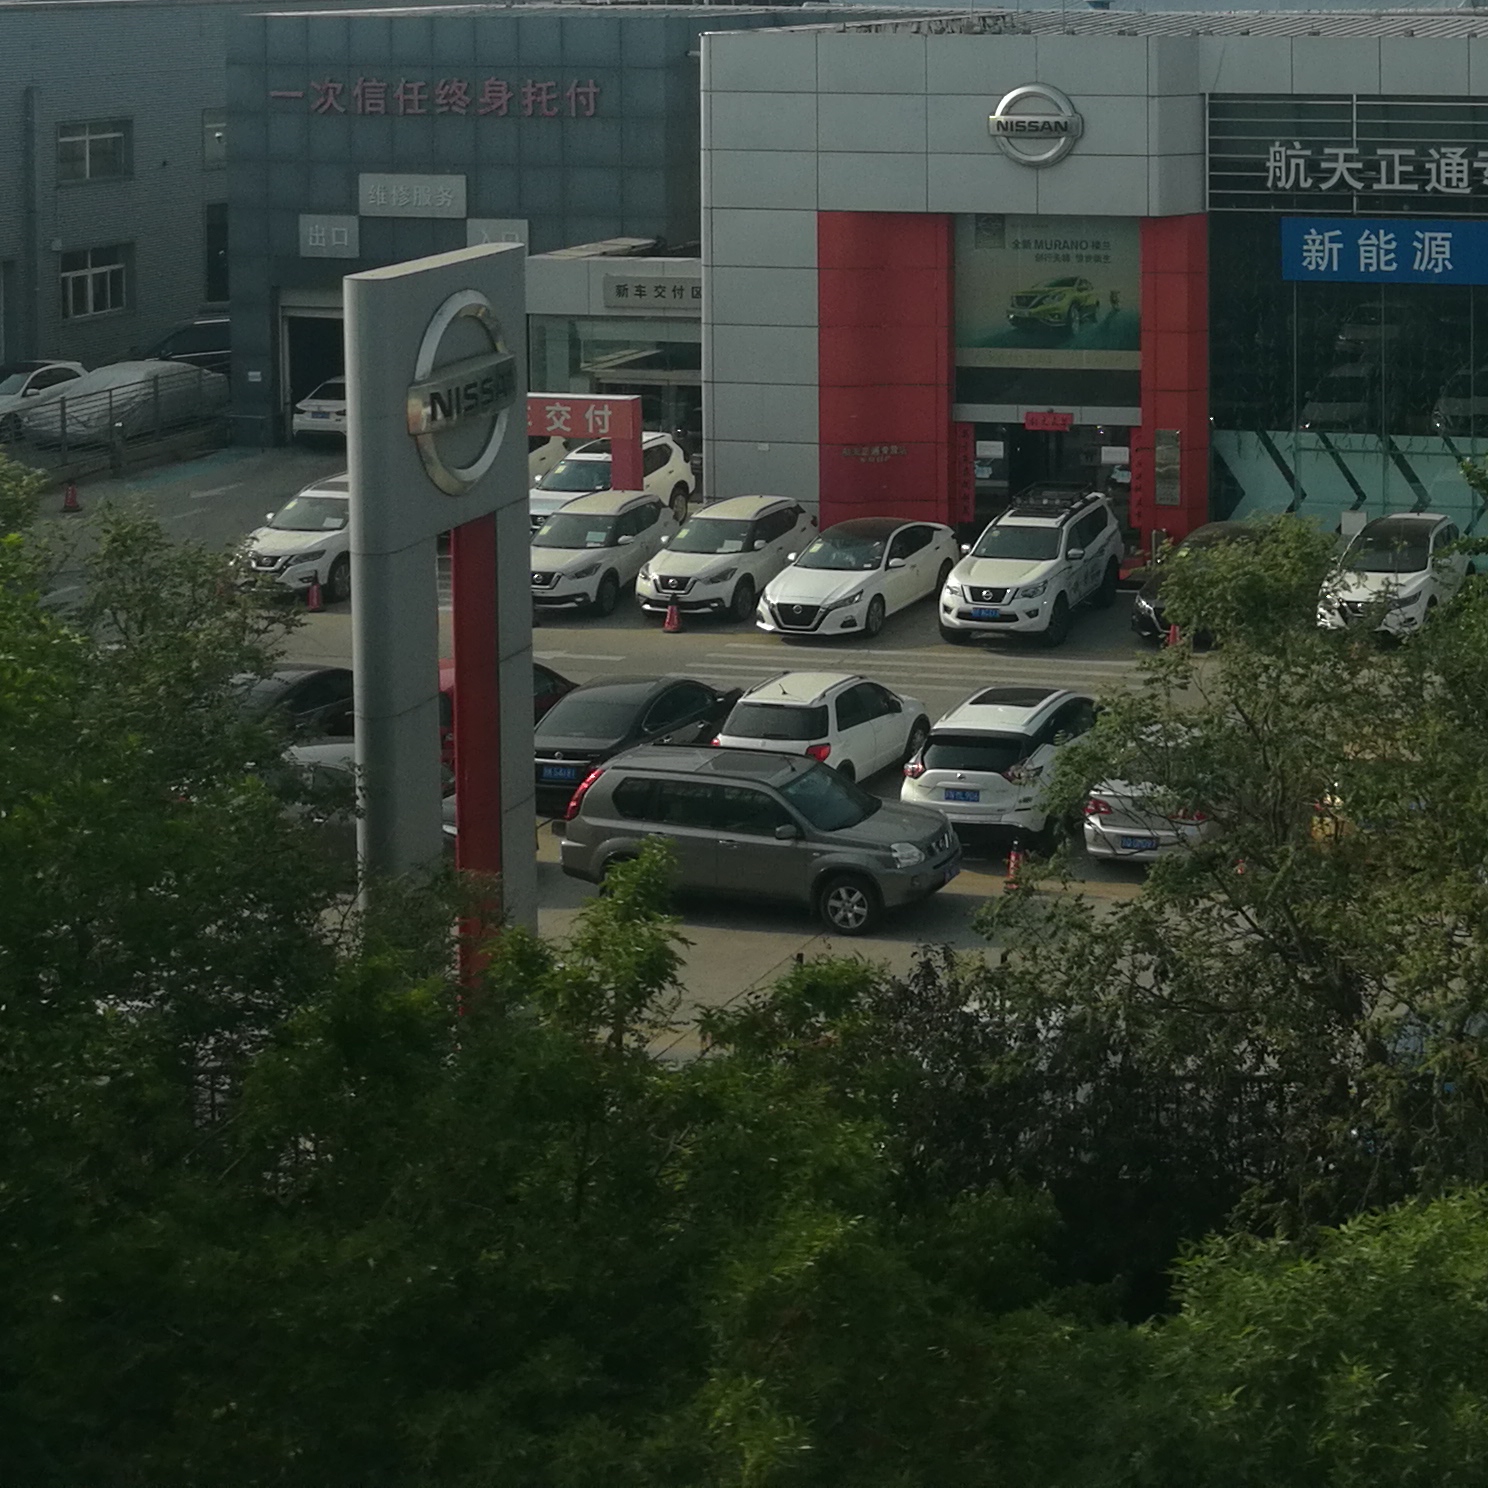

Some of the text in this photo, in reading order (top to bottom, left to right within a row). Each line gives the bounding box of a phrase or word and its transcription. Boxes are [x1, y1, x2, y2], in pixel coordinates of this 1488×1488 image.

[269, 76, 603, 119] 一次信任终身托付
[996, 120, 1069, 133] NISSAN
[368, 183, 454, 208] 维修服务
[309, 225, 349, 248] 出口
[1034, 239, 1089, 251] MURANO
[1301, 227, 1454, 274] 新能源
[615, 283, 702, 299] 新车交付区
[528, 402, 613, 434] 交付
